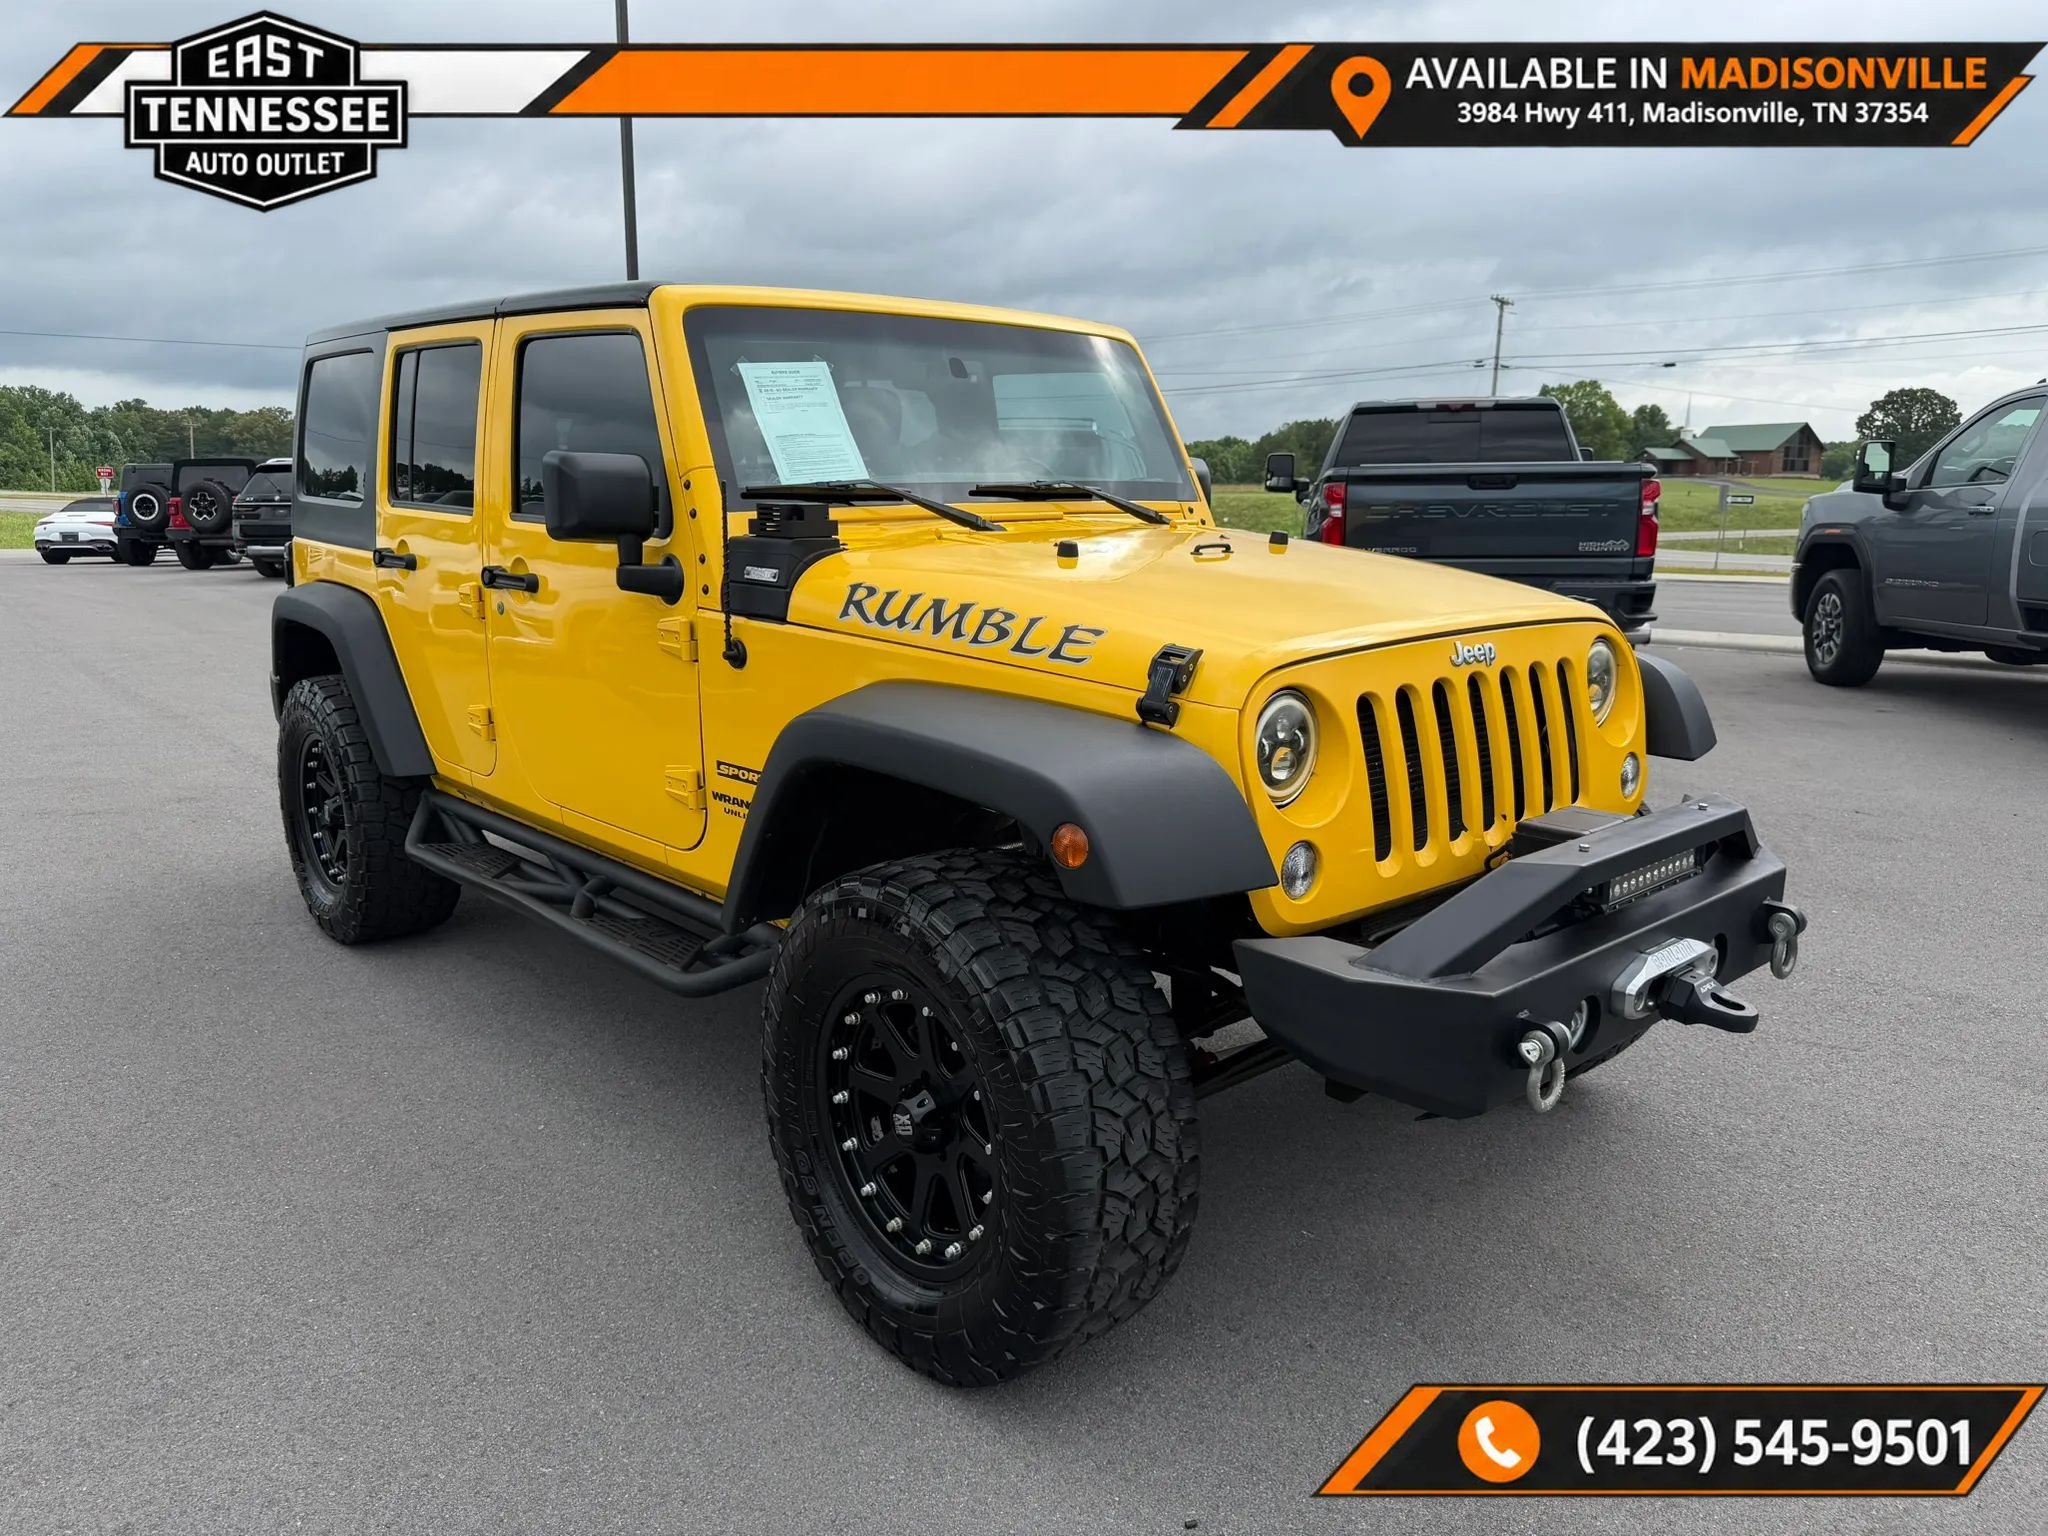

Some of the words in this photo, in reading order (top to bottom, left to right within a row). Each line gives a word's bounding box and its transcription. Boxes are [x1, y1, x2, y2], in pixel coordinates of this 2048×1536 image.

[838, 581, 1108, 667] RUMBLE
[1449, 640, 1496, 667] Jeep
[719, 764, 761, 783] SPOR
